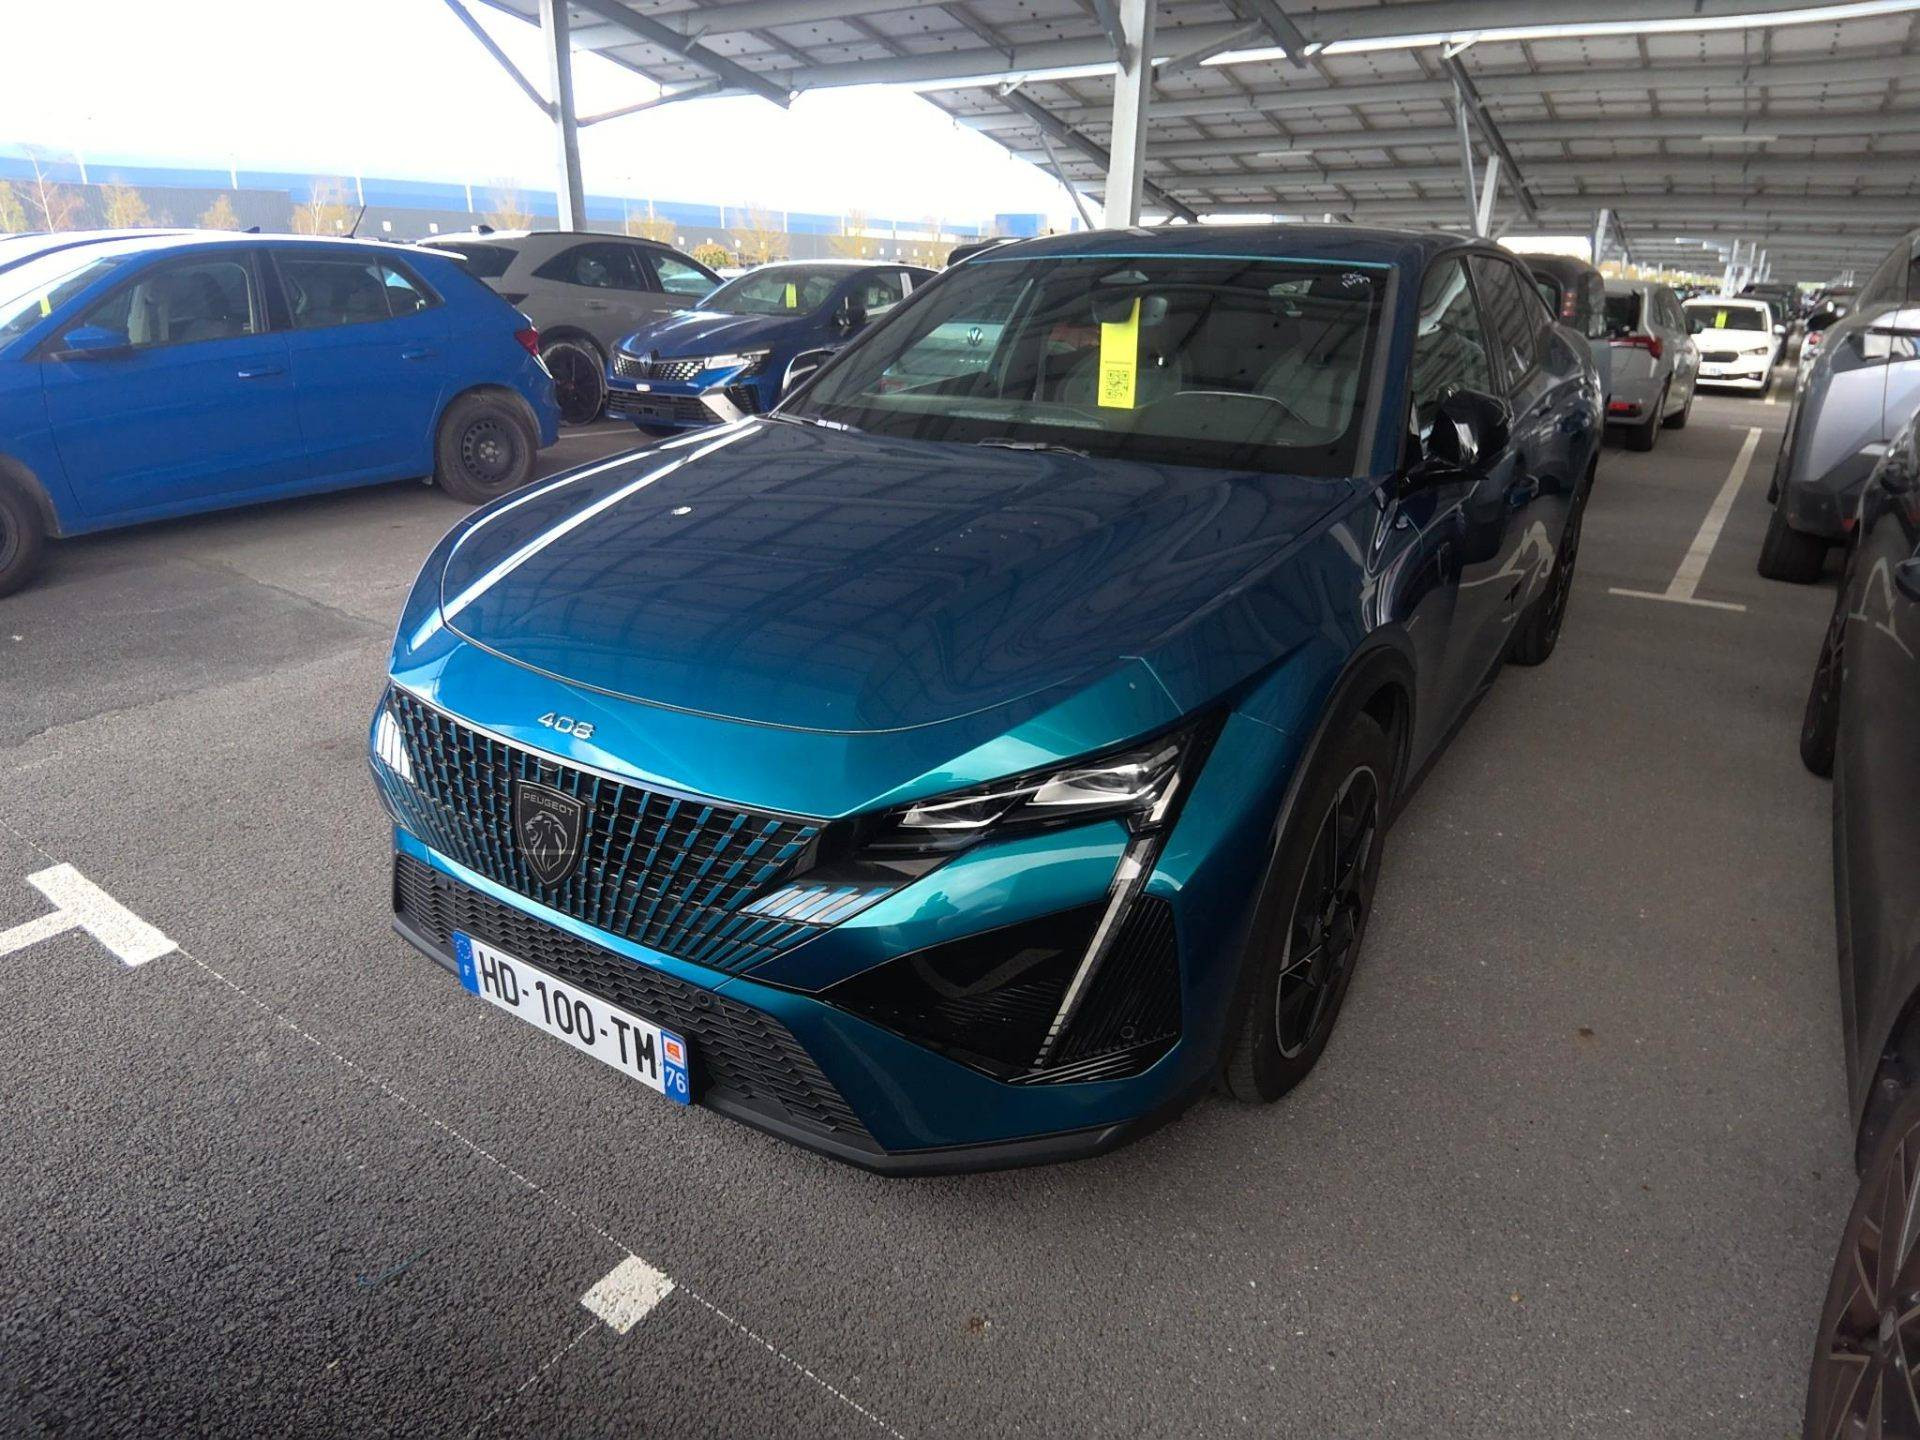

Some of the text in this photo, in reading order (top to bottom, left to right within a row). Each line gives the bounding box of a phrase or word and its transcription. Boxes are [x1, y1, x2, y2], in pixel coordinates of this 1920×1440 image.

[537, 711, 594, 740] 408
[523, 792, 575, 816] PEUGEOT
[463, 964, 471, 976] F
[478, 951, 657, 1080] HD-100-TM
[665, 1067, 687, 1094] 76
